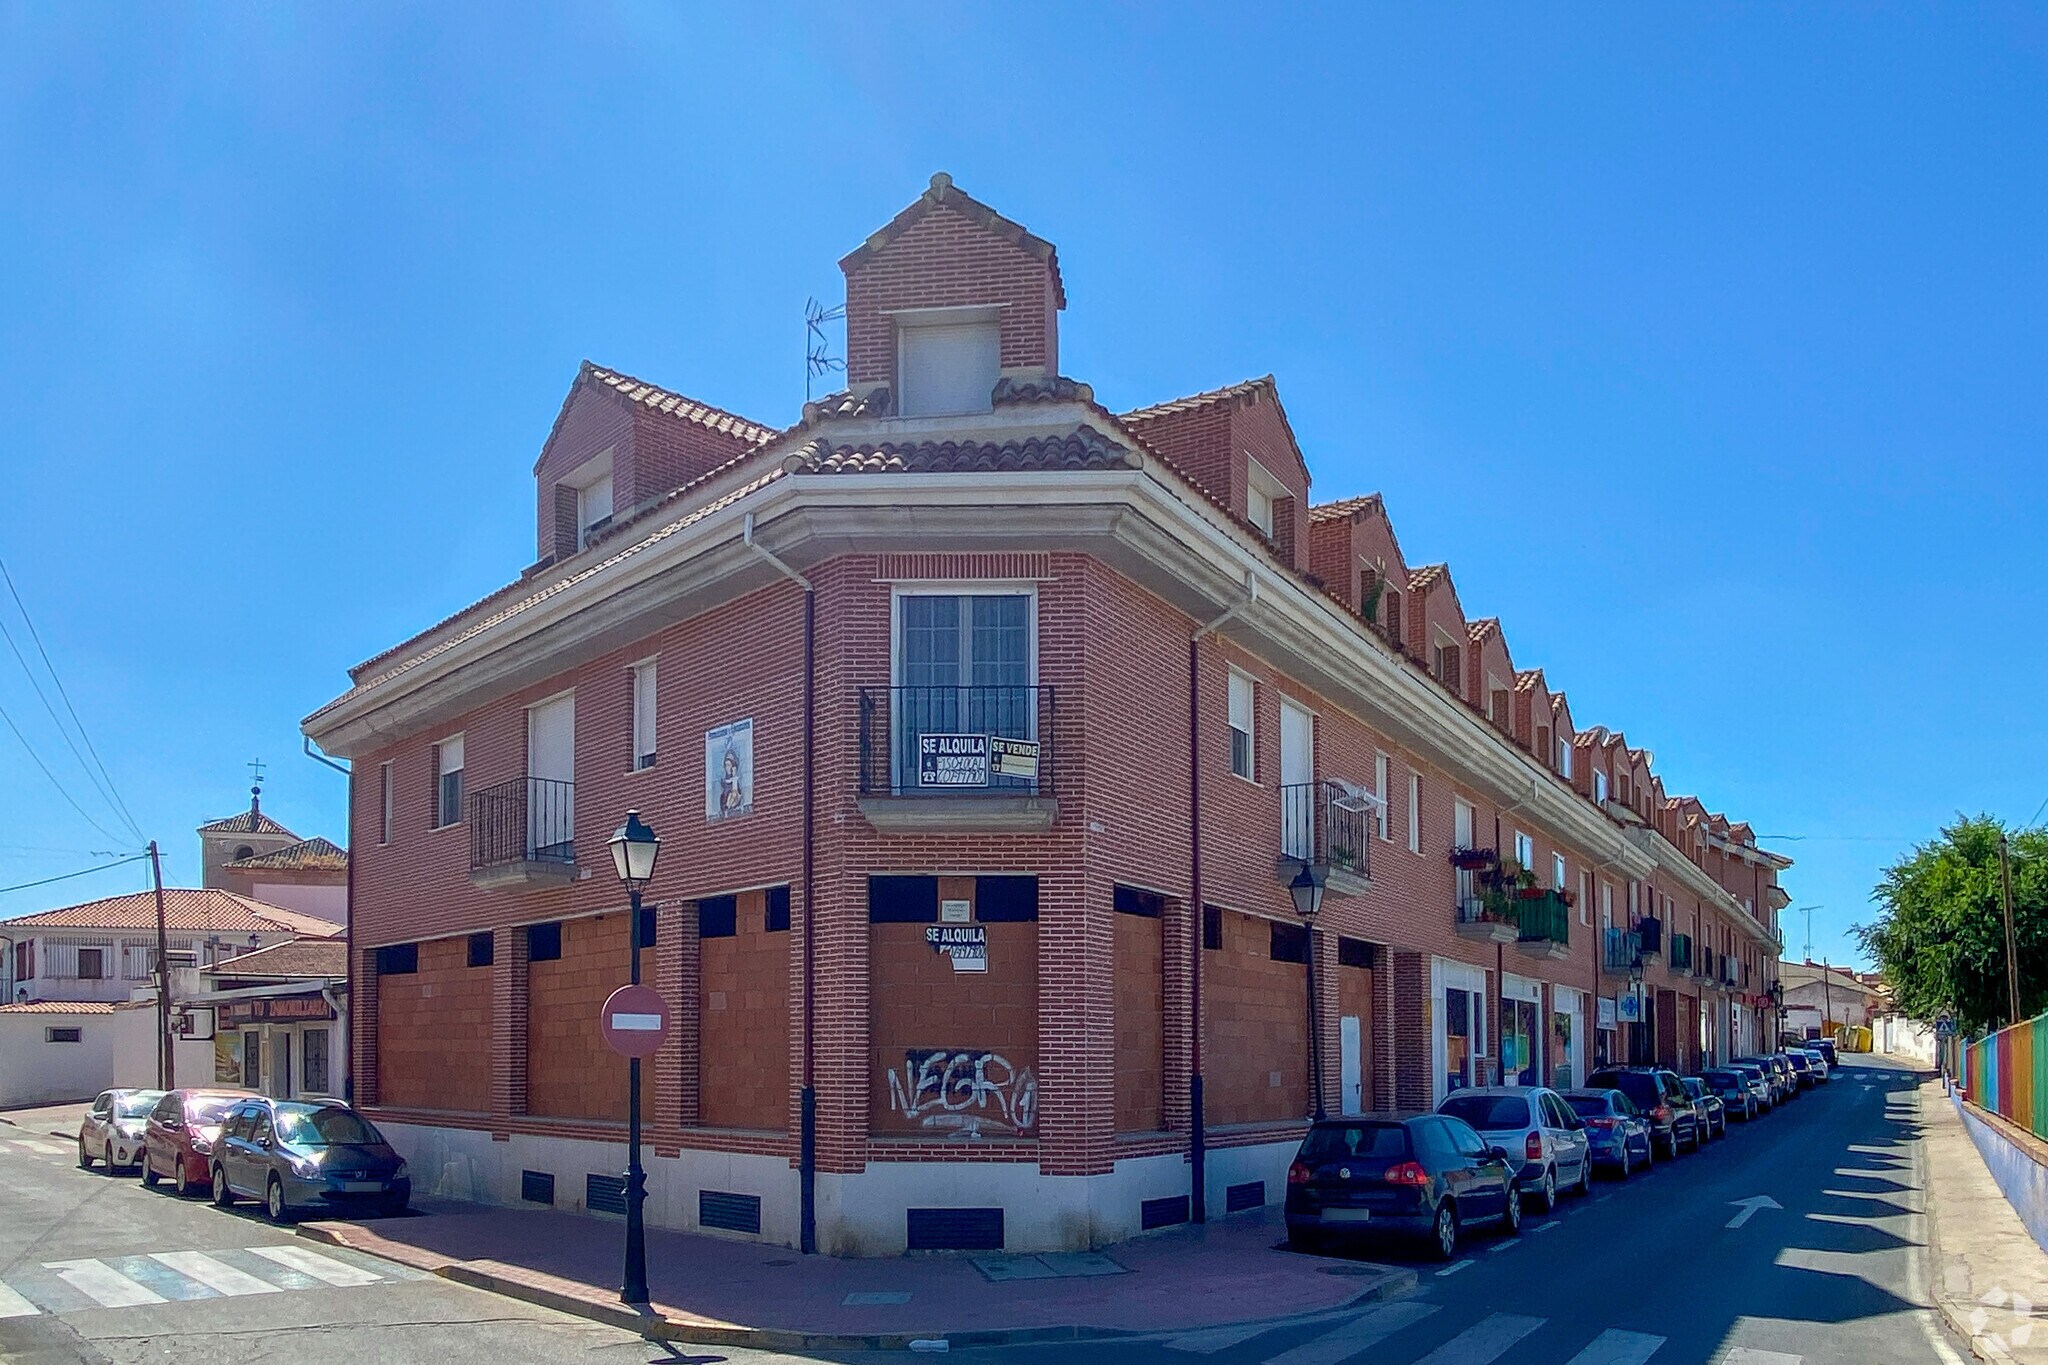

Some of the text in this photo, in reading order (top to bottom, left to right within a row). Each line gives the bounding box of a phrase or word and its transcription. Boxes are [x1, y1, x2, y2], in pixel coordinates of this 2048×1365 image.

[922, 738, 985, 754] SE ALQUILA
[992, 741, 1038, 756] SE VENDE
[926, 927, 985, 943] SE ALQUILA
